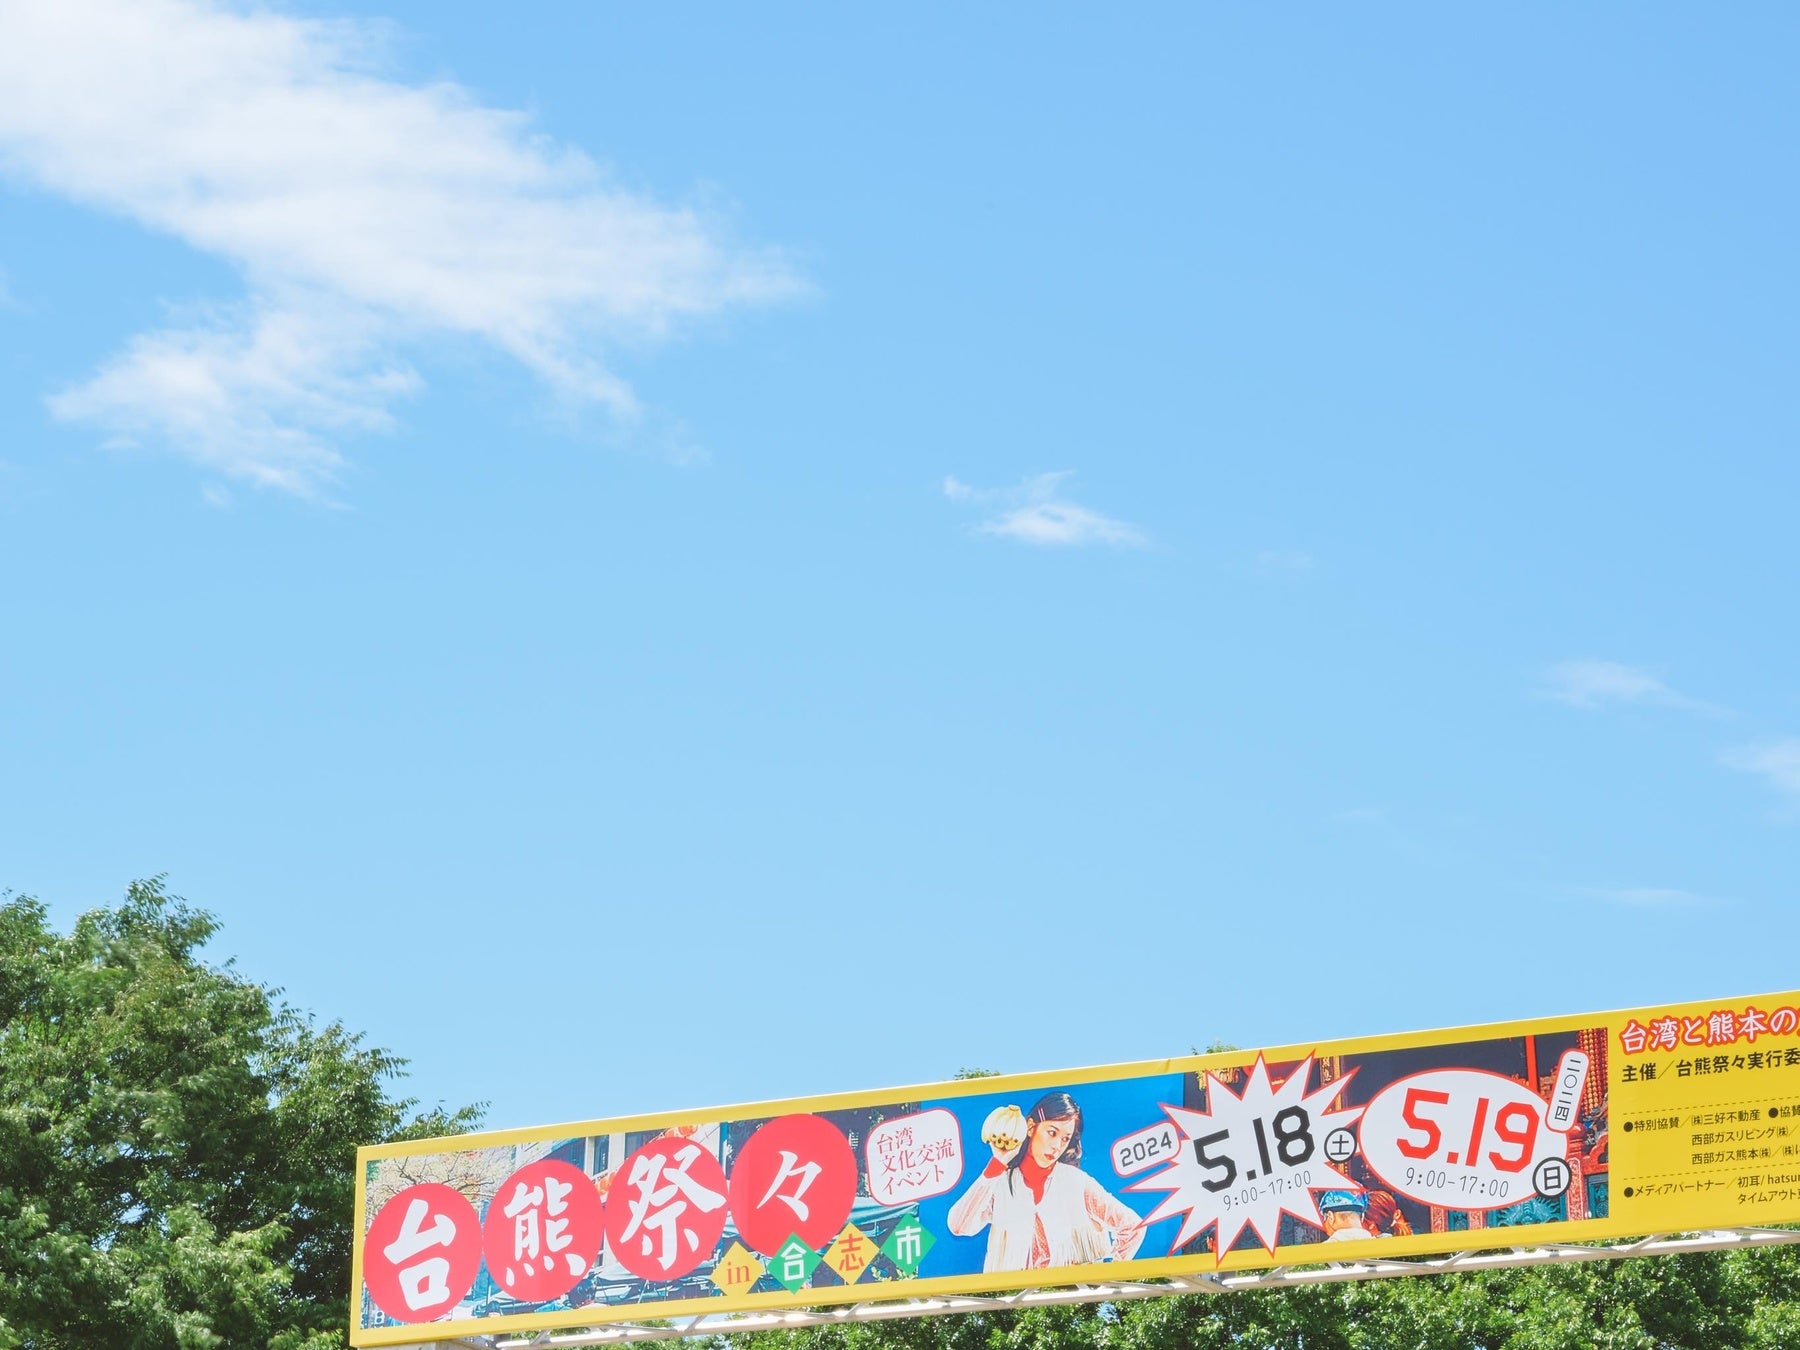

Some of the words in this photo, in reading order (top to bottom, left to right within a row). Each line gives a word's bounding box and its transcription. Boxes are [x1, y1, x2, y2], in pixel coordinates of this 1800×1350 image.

[1620, 1006, 1800, 1054] 台湾と熊本の
[876, 1126, 914, 1155] 台湾
[1330, 1134, 1352, 1157] 土
[1396, 1087, 1540, 1174] 5.19
[880, 1137, 956, 1173] 文化交流
[1119, 1131, 1173, 1168] 2024
[1193, 1105, 1316, 1194] 5.18
[882, 1167, 946, 1196] イベント
[1222, 1170, 1313, 1211] 9:00-17:00
[1405, 1166, 1510, 1199] 9:00-17:00
[1543, 1167, 1563, 1190] 日
[1767, 1174, 1800, 1185] hatsu
[725, 1263, 752, 1286] in
